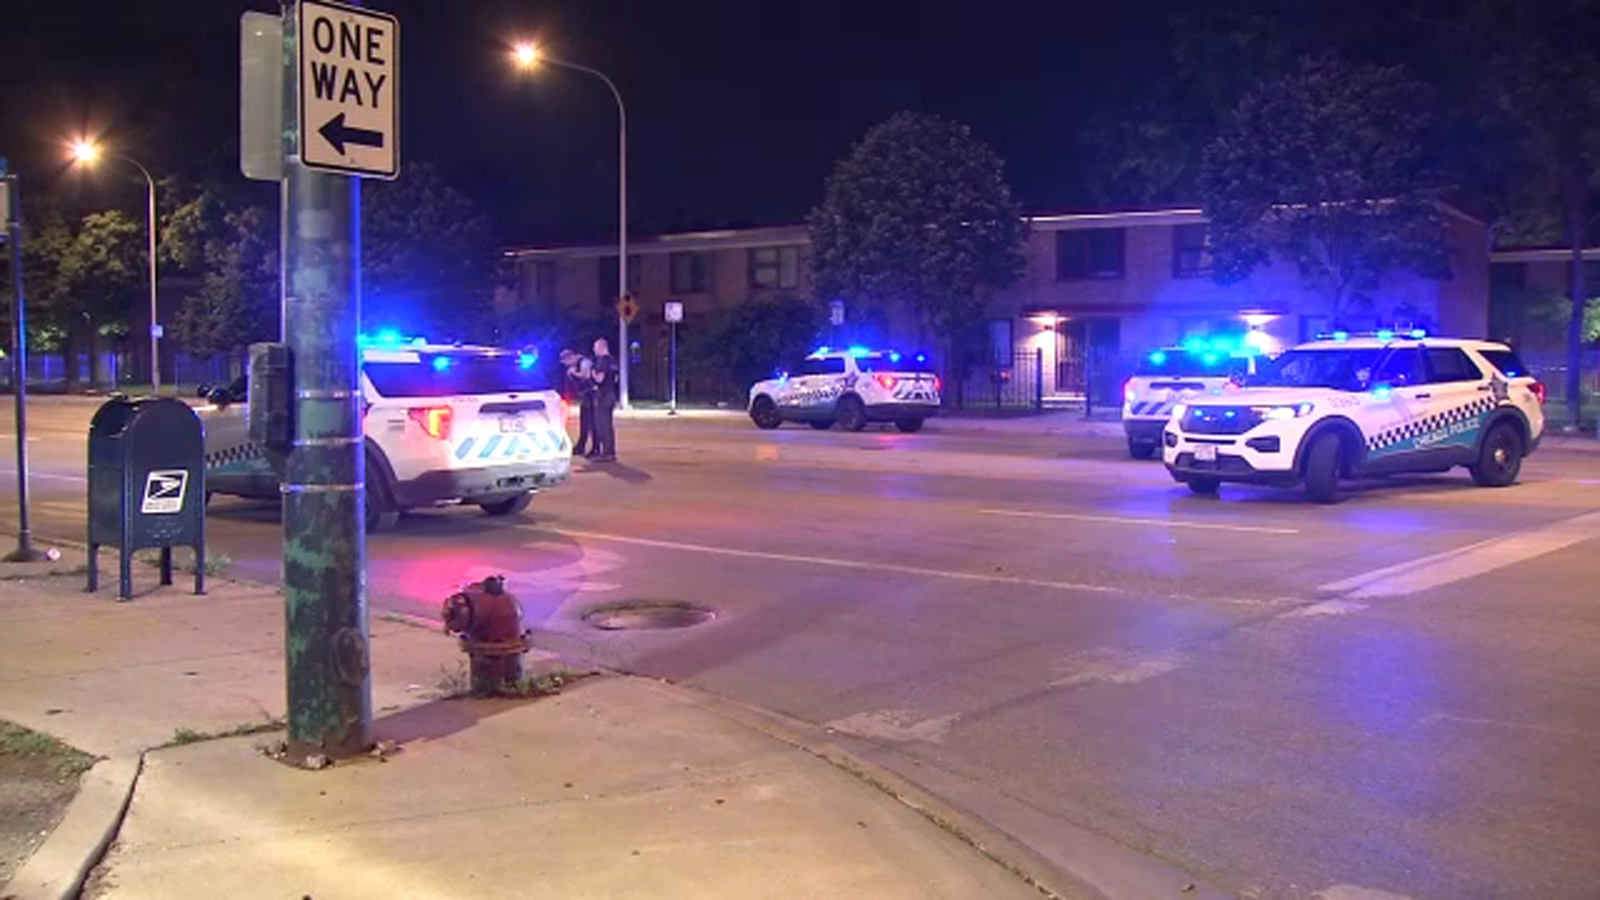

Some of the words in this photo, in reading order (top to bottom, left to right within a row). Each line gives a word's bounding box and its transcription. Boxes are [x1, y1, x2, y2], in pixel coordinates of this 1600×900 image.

[312, 16, 385, 65] ONE
[311, 60, 386, 108] WAY
[1449, 417, 1480, 434] POLICE
